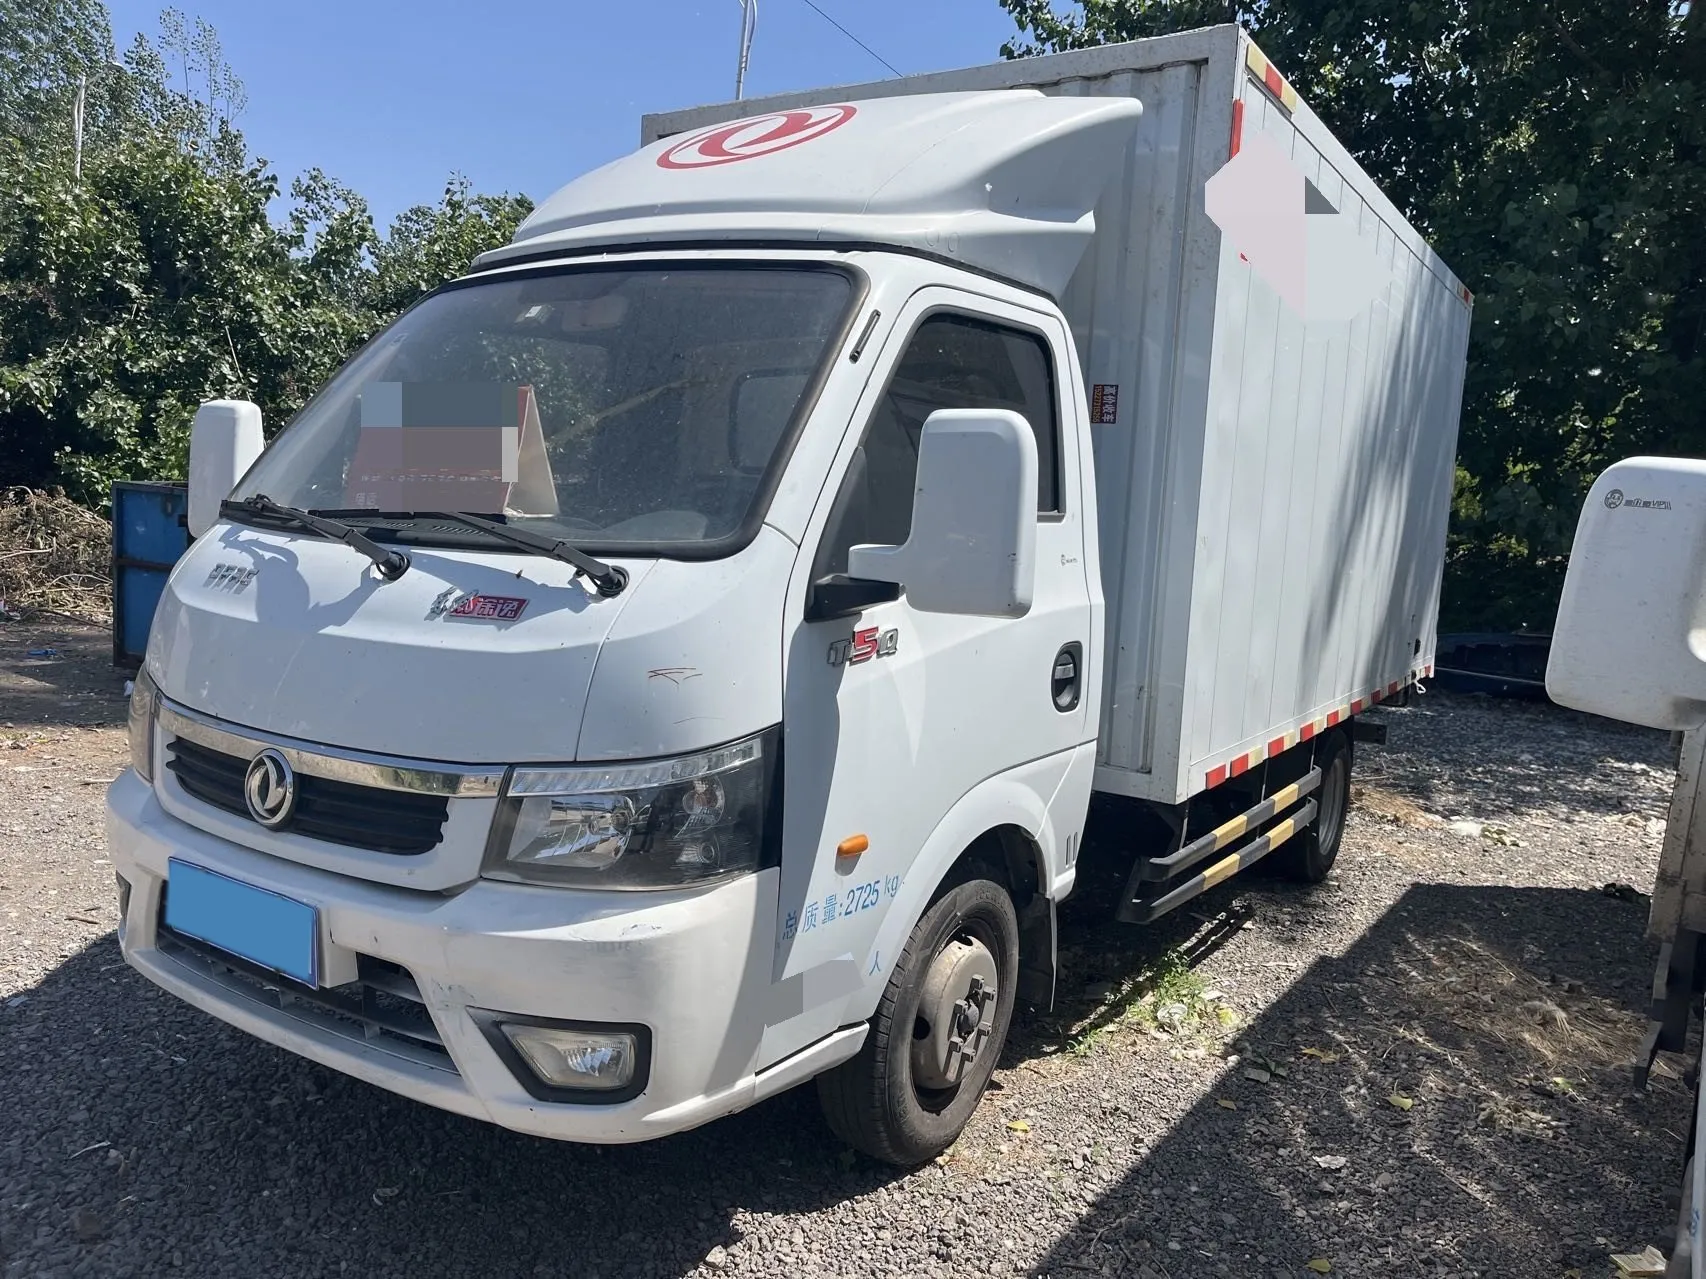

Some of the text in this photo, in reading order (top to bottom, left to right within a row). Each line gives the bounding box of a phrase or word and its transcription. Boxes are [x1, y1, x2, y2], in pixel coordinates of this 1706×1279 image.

[1101, 385, 1116, 423] 高价收车
[868, 950, 881, 976] 人
